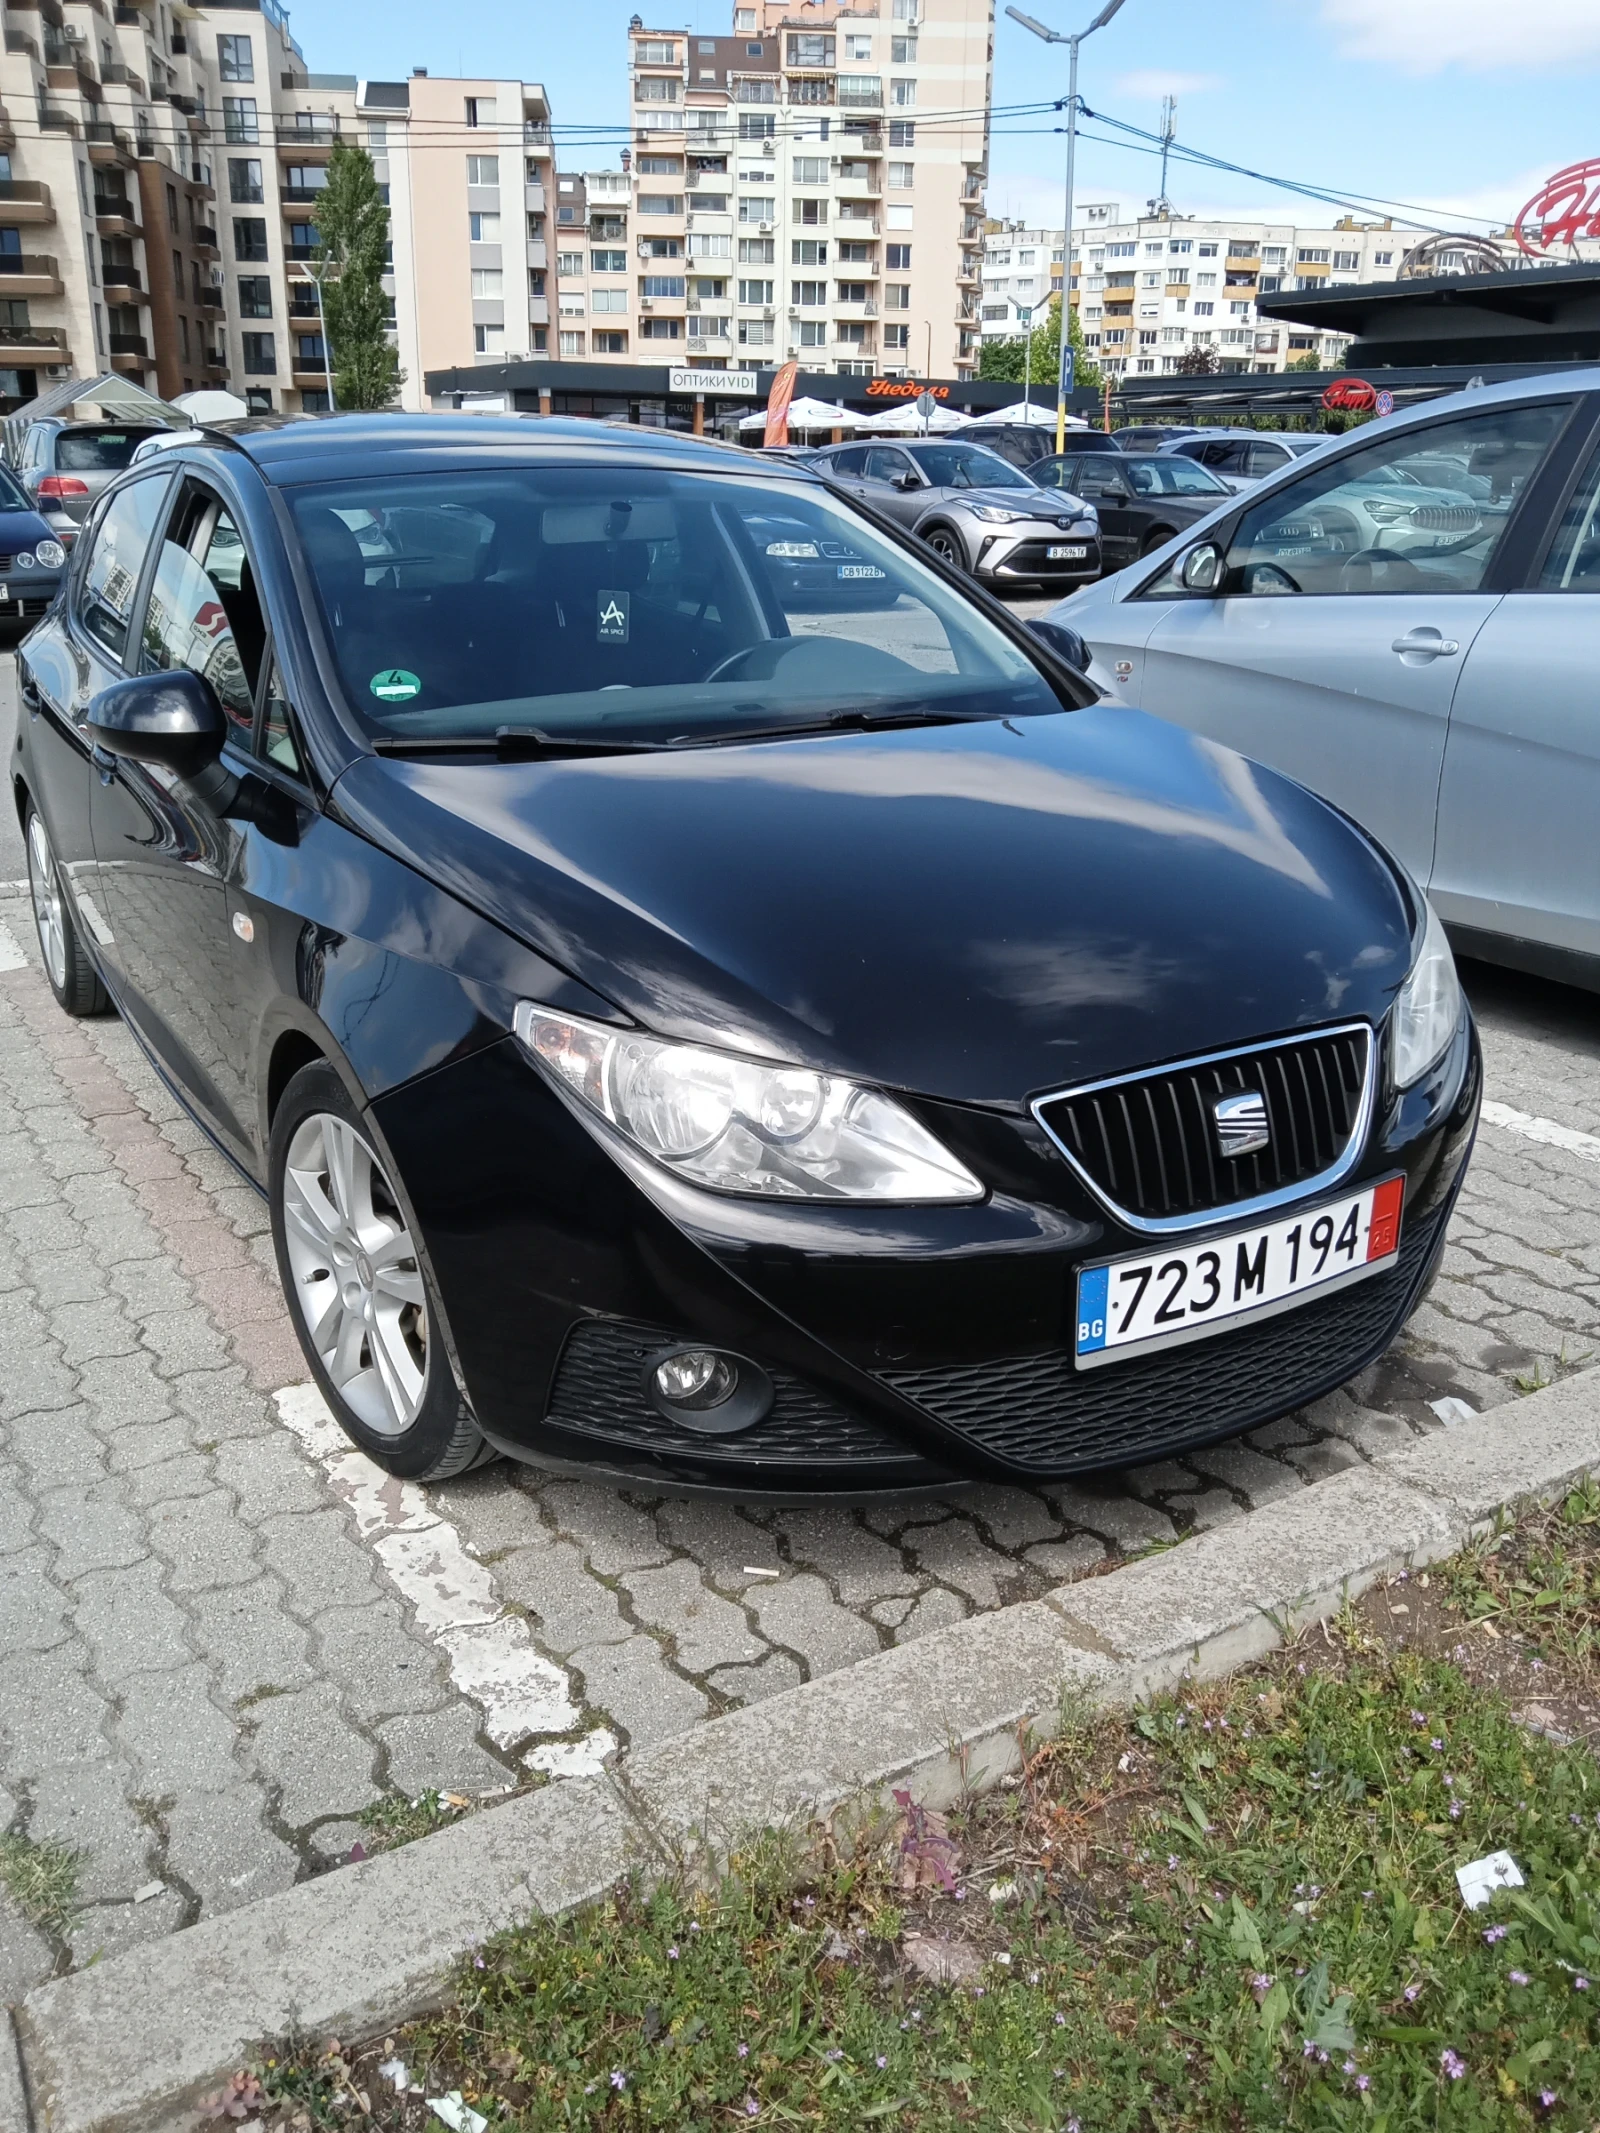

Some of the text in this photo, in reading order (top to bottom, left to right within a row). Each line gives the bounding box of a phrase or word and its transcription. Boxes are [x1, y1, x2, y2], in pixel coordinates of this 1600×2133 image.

[1064, 351, 1072, 387] P
[673, 373, 754, 389] ОПТИКИ VIDI
[843, 567, 855, 577] CB
[855, 567, 874, 577] 9122
[600, 627, 609, 635] AIR
[388, 670, 404, 685] 4
[1371, 1226, 1391, 1250] 25
[1117, 1203, 1360, 1334] 723 M 194
[1078, 1318, 1103, 1342] BG
